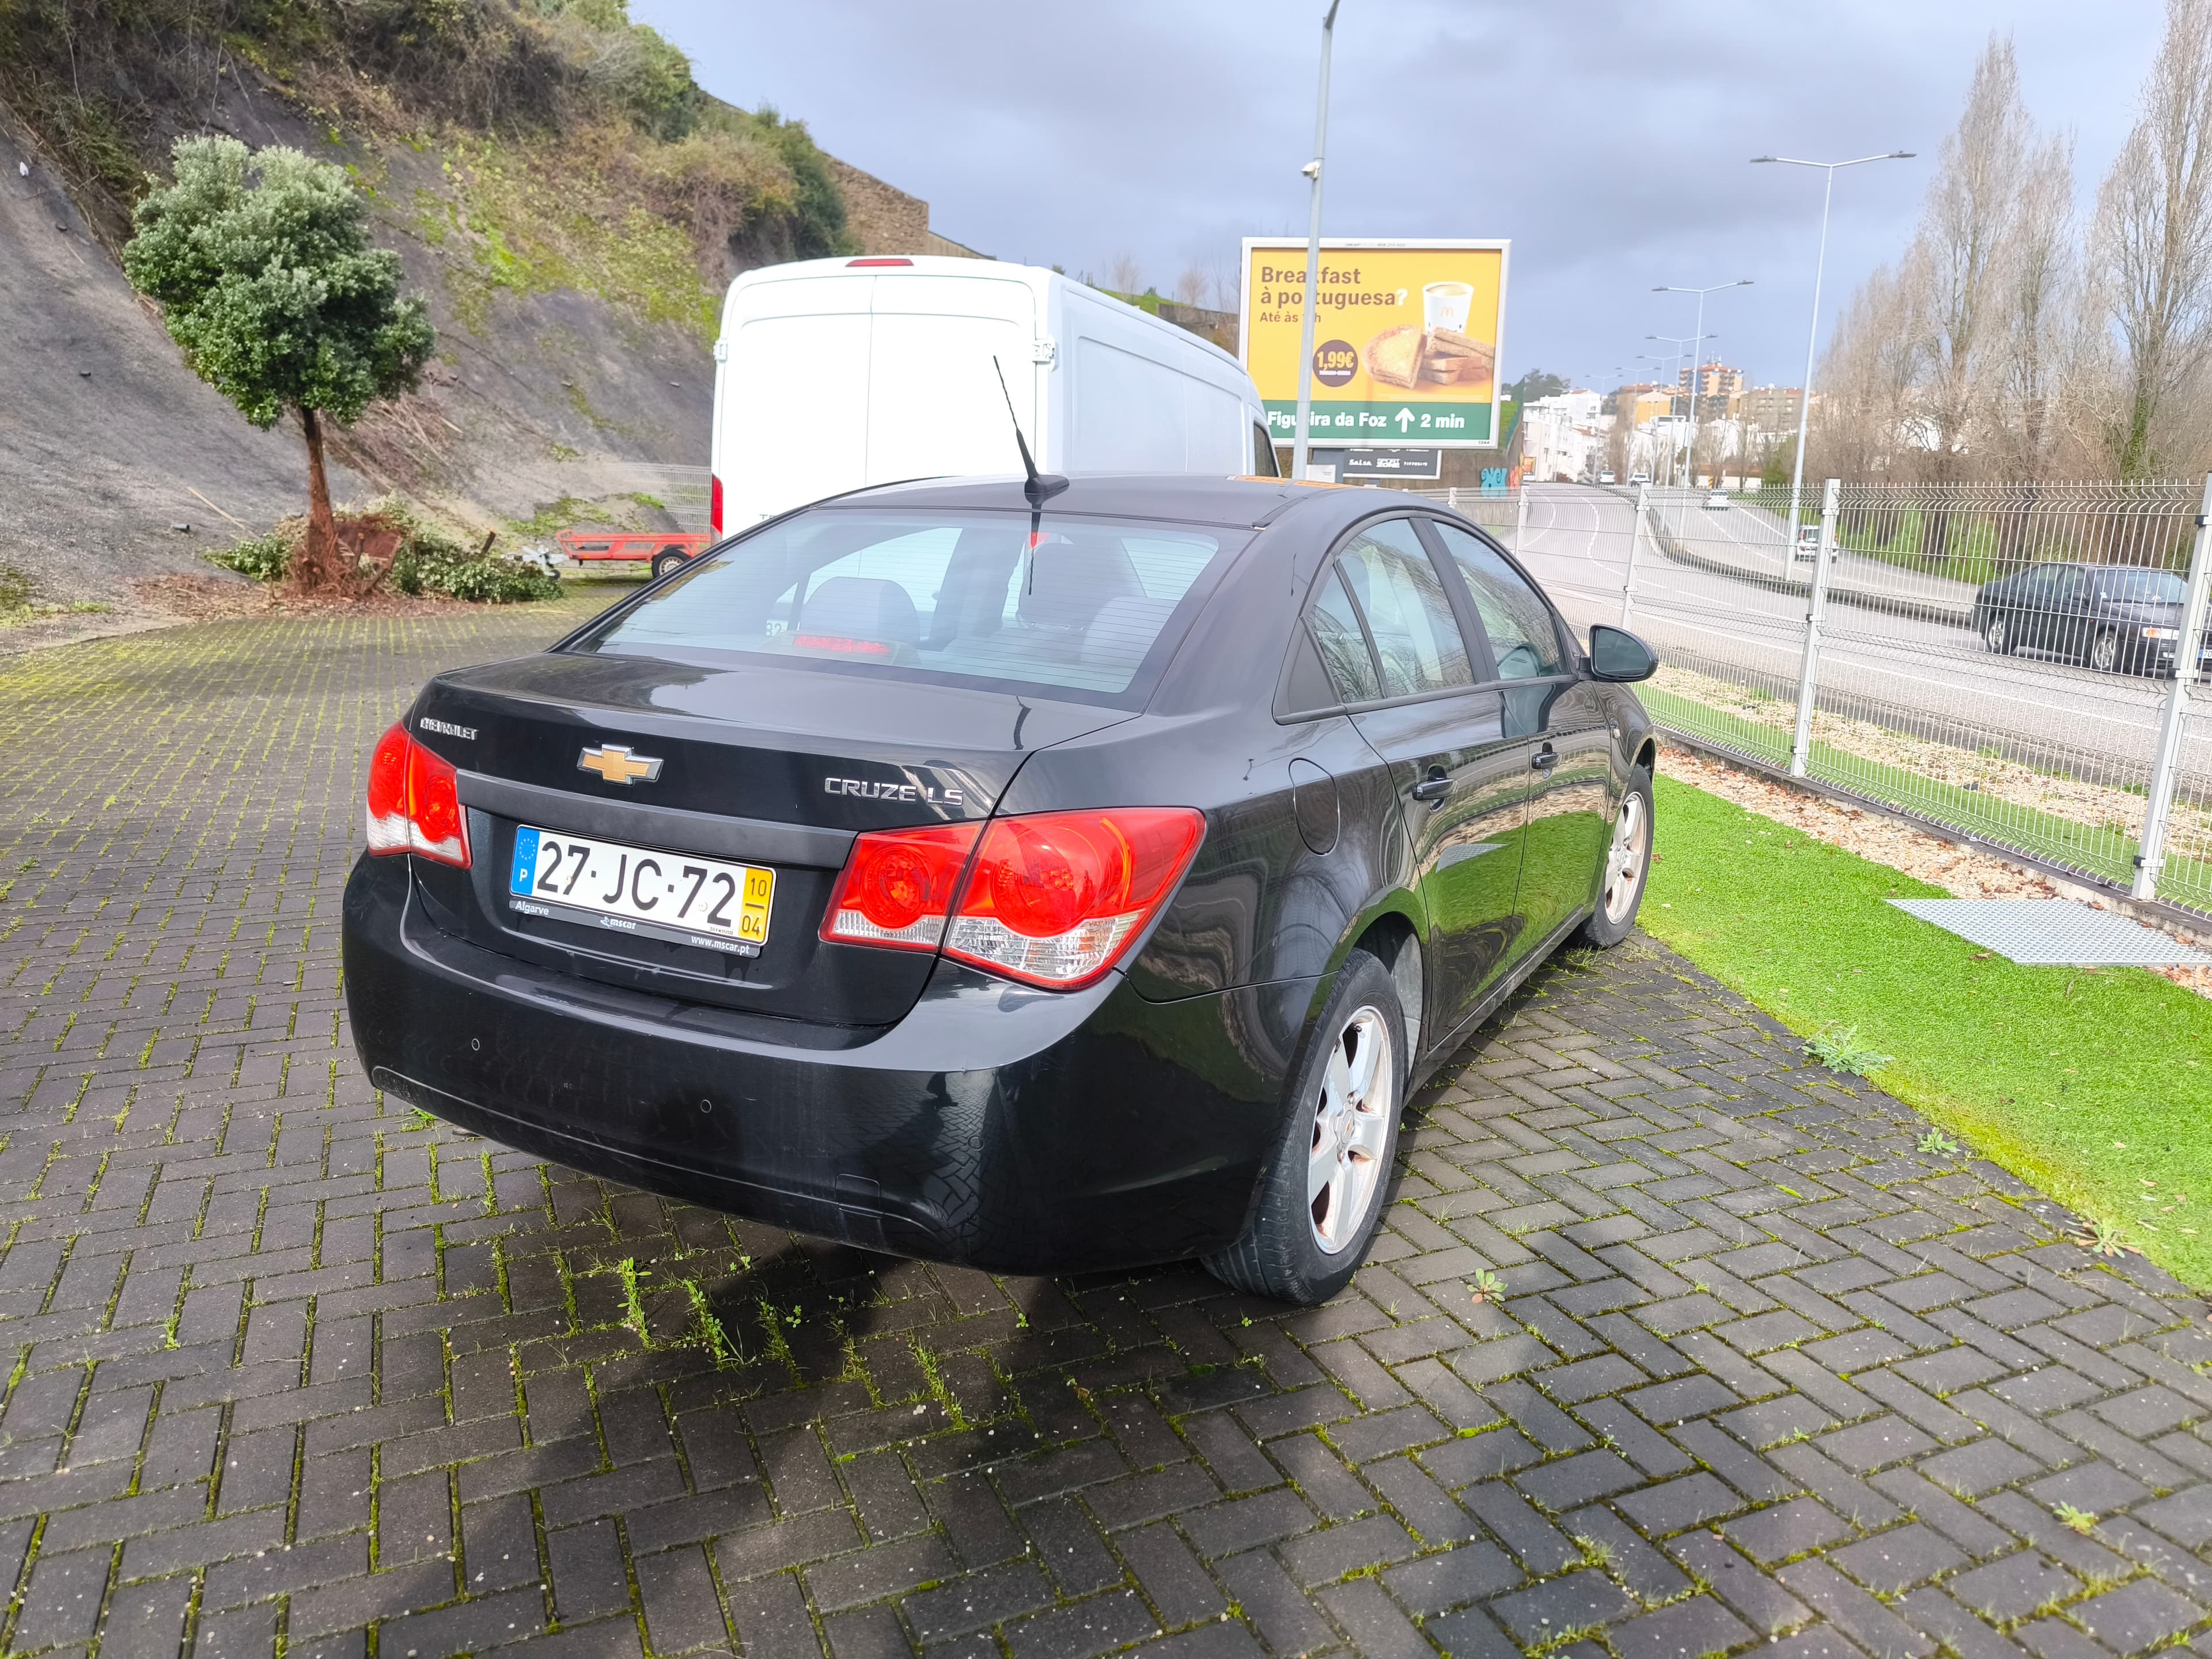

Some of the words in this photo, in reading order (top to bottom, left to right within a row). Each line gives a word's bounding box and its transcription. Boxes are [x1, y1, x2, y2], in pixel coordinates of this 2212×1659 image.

[1262, 266, 1361, 284] Breafast
[1260, 286, 1271, 304] à
[1278, 288, 1408, 310] potuguesa?
[1260, 311, 1281, 322] Até
[1284, 312, 1298, 322] às
[1317, 351, 1354, 370] 1,99€
[1267, 411, 1331, 429] Figuira
[1335, 412, 1354, 426] da
[1359, 412, 1387, 427] Foz
[1420, 414, 1431, 428] 2
[1435, 413, 1465, 429] min
[825, 778, 917, 802] CRUZE
[927, 787, 963, 806] LS
[520, 868, 528, 882] P
[750, 877, 767, 897] 10
[515, 902, 550, 915] Algarve
[741, 915, 760, 935] 04
[691, 935, 750, 956] www.mscar.pt
